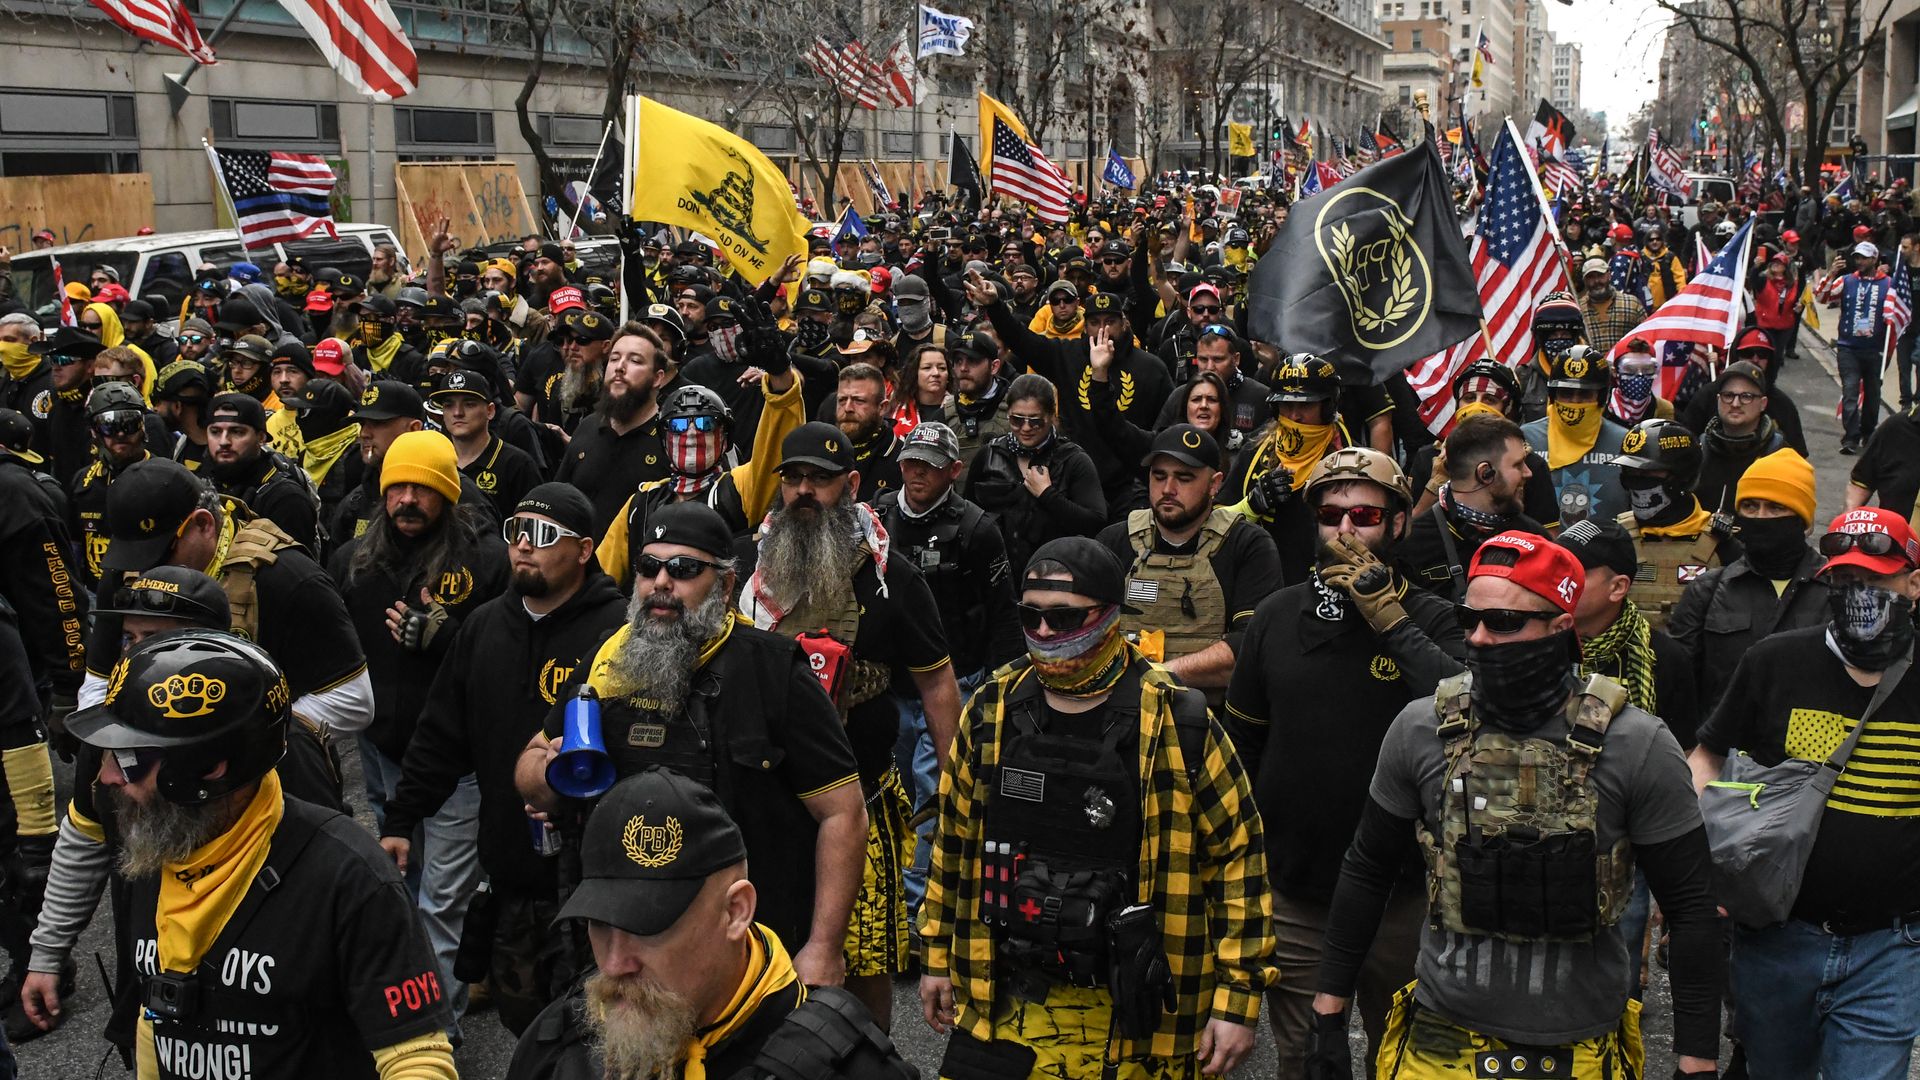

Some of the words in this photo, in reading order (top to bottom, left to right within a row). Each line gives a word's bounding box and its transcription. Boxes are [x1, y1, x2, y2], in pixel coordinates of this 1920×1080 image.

[733, 244, 749, 258] ON
[748, 255, 765, 270] ME
[1570, 361, 1581, 373] PB
[1627, 433, 1639, 446] PB
[1836, 522, 1888, 534] MERICA
[1844, 510, 1878, 523] KEEP
[43, 542, 76, 613] PROUD
[140, 578, 179, 593] AMERICA
[1557, 576, 1577, 604] 45
[630, 697, 659, 710] PROUD
[640, 826, 666, 851] PB
[221, 947, 276, 994] OYS
[384, 971, 441, 1017] POYB
[155, 1035, 251, 1080] WRONG!
